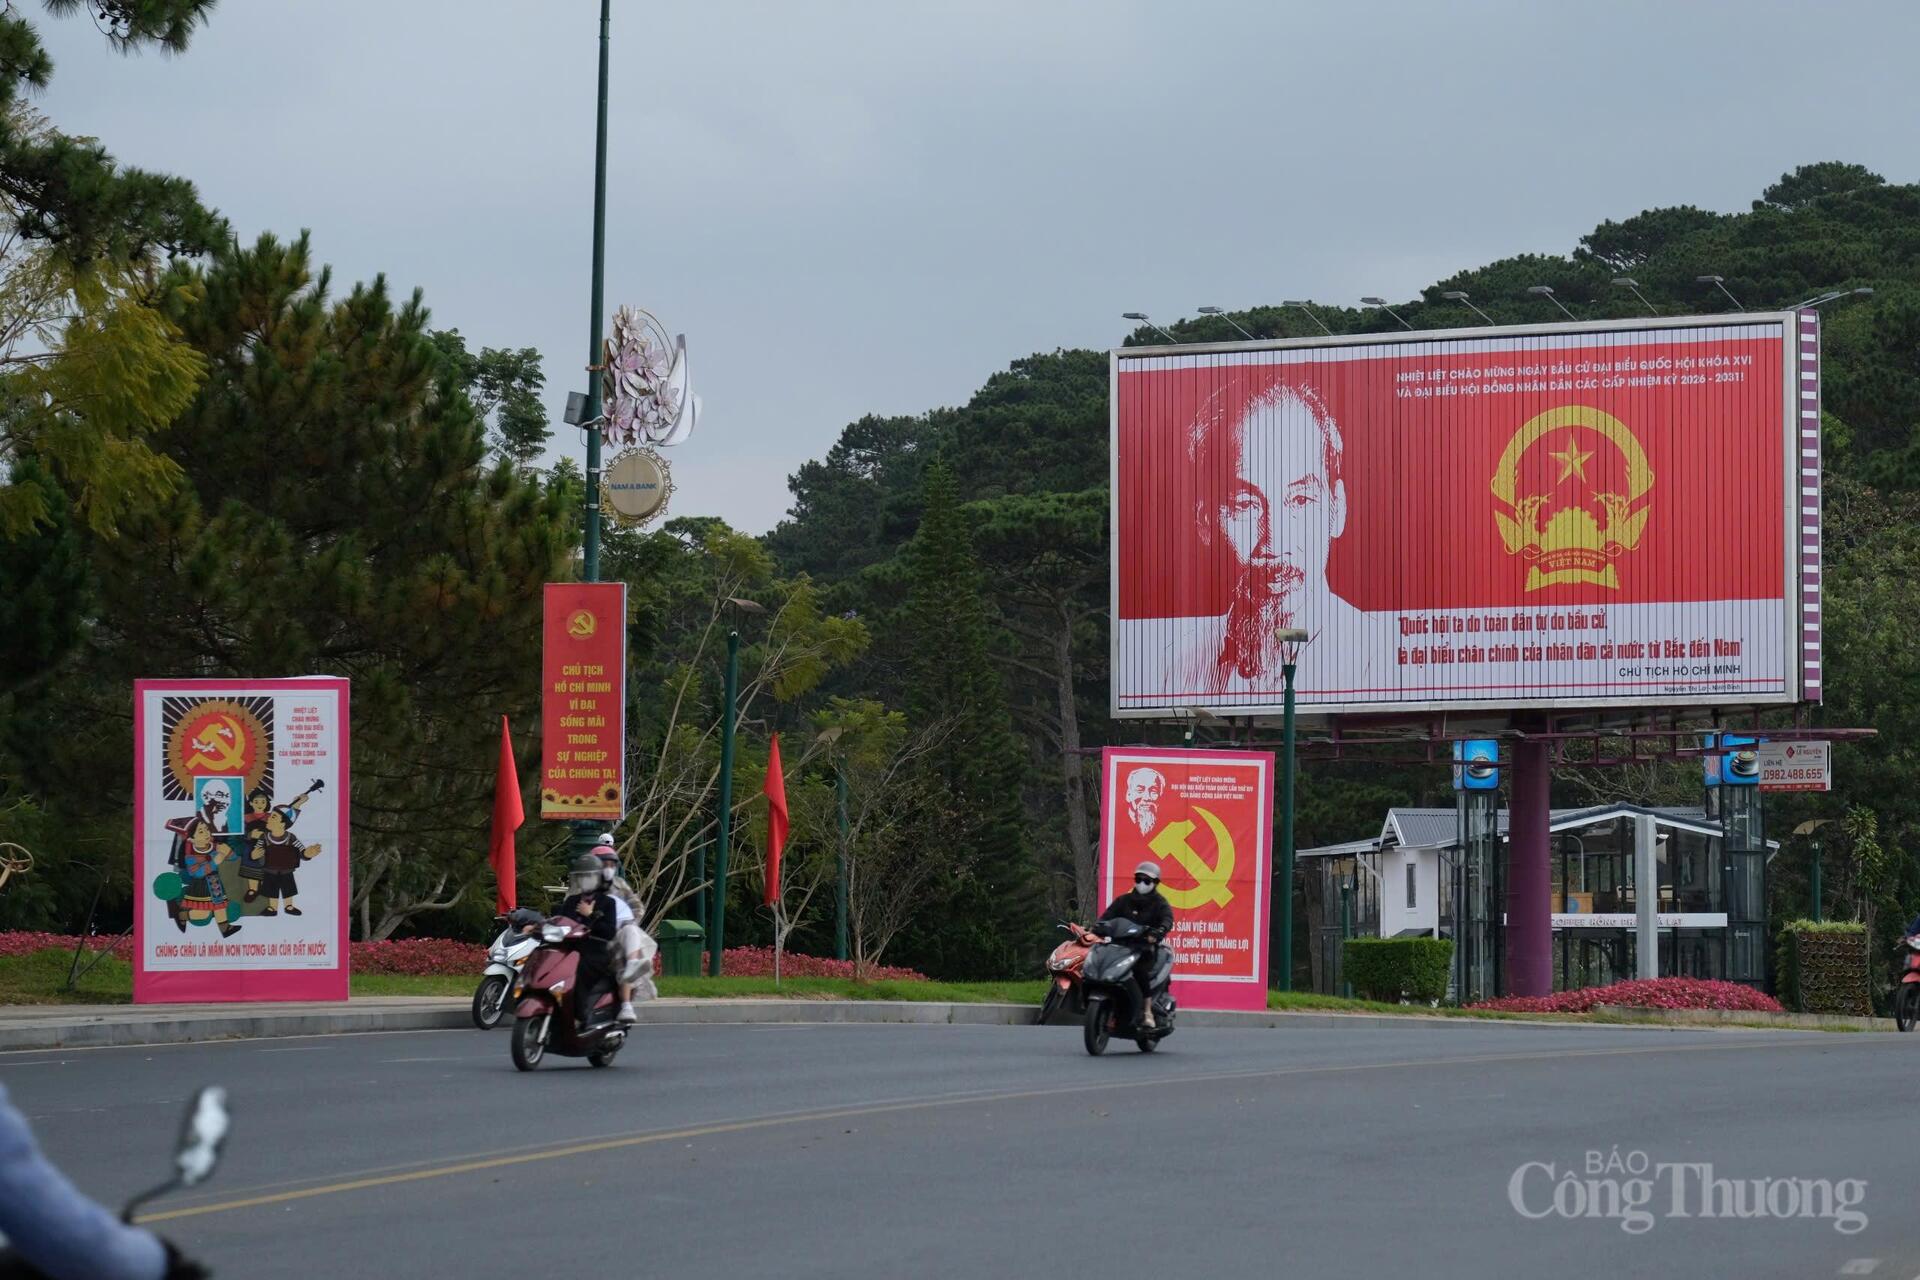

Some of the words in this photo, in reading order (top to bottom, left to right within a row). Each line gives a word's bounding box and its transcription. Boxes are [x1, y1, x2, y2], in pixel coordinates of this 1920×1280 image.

[1397, 369, 1424, 384] NHIỆT
[1428, 368, 1446, 384] LIỆT
[1450, 366, 1481, 379] CHÀO
[1485, 365, 1514, 378] MỪNG
[1518, 364, 1547, 376] NGÀY
[1552, 361, 1571, 374] BẦU
[1575, 360, 1590, 373] CỬ
[1593, 360, 1611, 374] ĐẠI
[1615, 357, 1636, 371] BIỂU
[1640, 356, 1672, 370] QUỐC
[1675, 357, 1694, 371] HỘI
[1698, 355, 1730, 368] KHÓA
[1733, 355, 1752, 365] XVI
[1397, 386, 1411, 398] VÀ
[1415, 386, 1432, 399] ĐẠI
[1436, 383, 1457, 396] BIỂU
[1460, 383, 1479, 397] HỘI
[1483, 380, 1514, 394] ĐỒNG
[1517, 381, 1546, 392] NHÂN
[1551, 380, 1572, 391] DÂN
[1575, 376, 1599, 389] CÁC
[1602, 375, 1624, 388] CẤP
[1628, 375, 1661, 388] NHIỆM
[1664, 374, 1677, 385] KỲ
[1681, 376, 1705, 385] 2026
[1715, 372, 1744, 383] 2031!
[1432, 615, 1448, 638] hội
[1453, 616, 1463, 632] ta
[1467, 615, 1480, 632] do
[1484, 613, 1508, 632] toàn
[1512, 613, 1533, 632] dân
[1536, 614, 1547, 635] tự
[1551, 612, 1564, 630] do
[1568, 609, 1588, 630] bầu
[1398, 647, 1408, 665] là
[1412, 645, 1428, 669] đại
[1431, 642, 1454, 664] biểu
[1458, 645, 1485, 663] chân
[1489, 643, 1519, 662] chính
[1523, 641, 1542, 661] của
[1547, 643, 1573, 661] nhân
[1577, 642, 1597, 660] dân
[1600, 640, 1613, 660] cả
[1618, 640, 1645, 660] nước
[1648, 640, 1661, 659] từ
[1664, 637, 1686, 659] Bắc
[1690, 636, 1711, 658] đến
[563, 662, 581, 676] CHỦ
[584, 665, 603, 678] TỊCH
[1619, 666, 1641, 677] CHỦ
[1645, 666, 1669, 679] TỊCH
[1692, 664, 1710, 676] CHÍ
[1714, 665, 1741, 675] MINH
[555, 681, 567, 693] HỒ
[569, 681, 584, 693] CHÍ
[587, 683, 611, 693] MINH
[581, 700, 596, 712] ĐẠI
[560, 714, 585, 727] SỐNG
[587, 716, 605, 727] MÃI
[568, 735, 597, 745] TRONG
[557, 751, 570, 763] SỰ
[575, 750, 608, 764] NGHIỆP
[548, 766, 567, 779] CỦA
[569, 766, 600, 779] CHÚNG
[603, 769, 616, 779] TA!
[1177, 918, 1191, 932] SẢN
[1193, 920, 1207, 934] VIỆT
[1208, 922, 1225, 932] NAM
[226, 944, 241, 957] NON
[268, 944, 278, 956] LAI
[1183, 936, 1200, 949] CHỨC
[1201, 939, 1214, 951] MỌI
[1216, 936, 1237, 950] THẮNG
[1239, 939, 1249, 952] LỢI
[1190, 952, 1204, 966] VIỆT
[1205, 954, 1223, 965] NAM!
